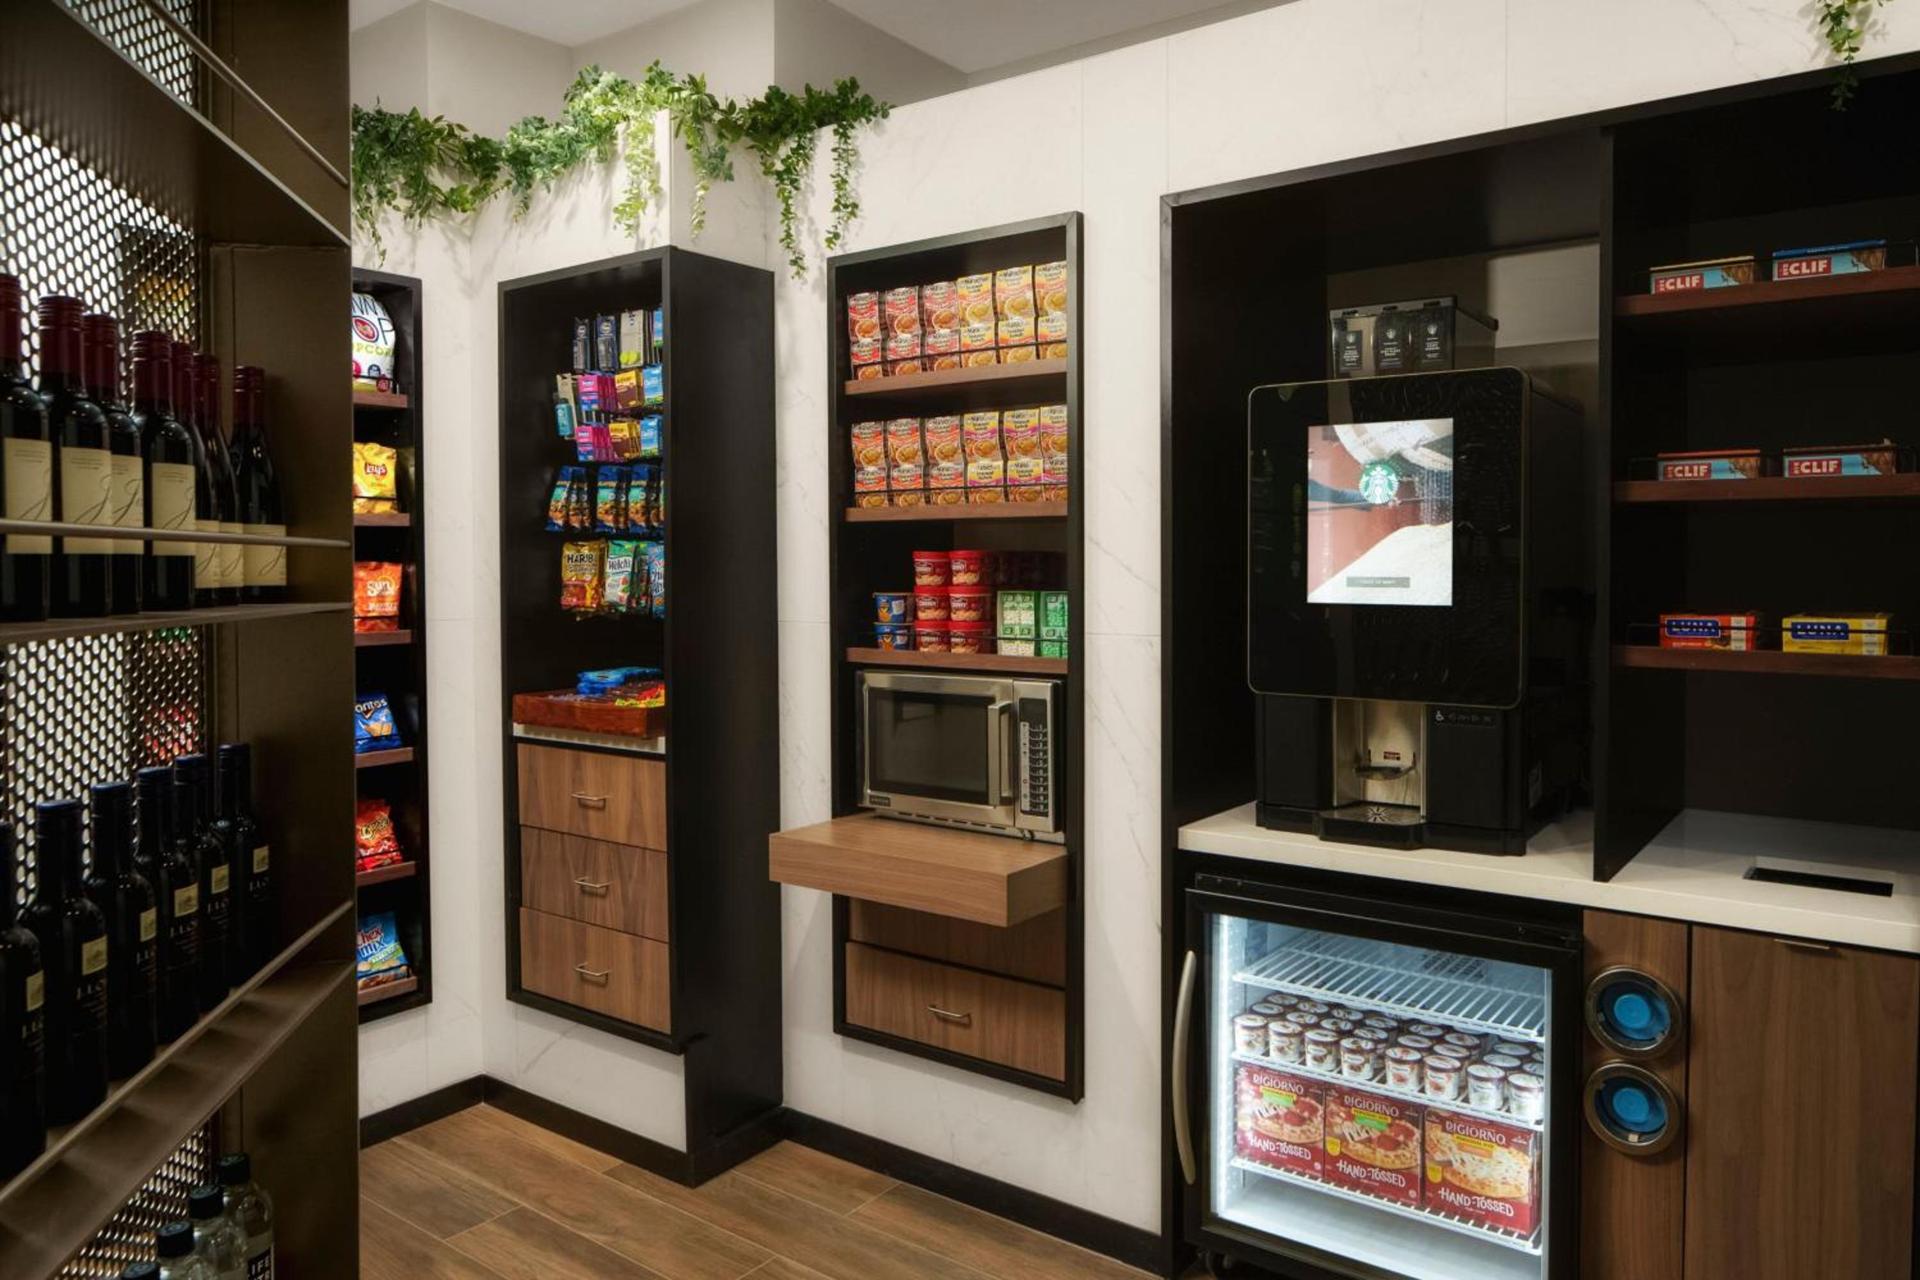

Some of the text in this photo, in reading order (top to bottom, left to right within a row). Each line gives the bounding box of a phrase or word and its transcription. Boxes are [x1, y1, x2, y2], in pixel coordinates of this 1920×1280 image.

[1788, 259, 1828, 276] CLIF
[1665, 275, 1701, 290] CLIF
[1673, 465, 1709, 477] CLIF
[1800, 460, 1839, 473] CLIF
[1253, 1074, 1304, 1095] DIGIORNO
[1344, 1095, 1399, 1117] DIGIORNO
[1445, 1121, 1506, 1146] DIGIORNO
[1246, 1132, 1312, 1160] HAND-TOSSED
[1336, 1159, 1406, 1187] HAND-TOSSED
[1438, 1187, 1514, 1217] HAND-TOSSED
